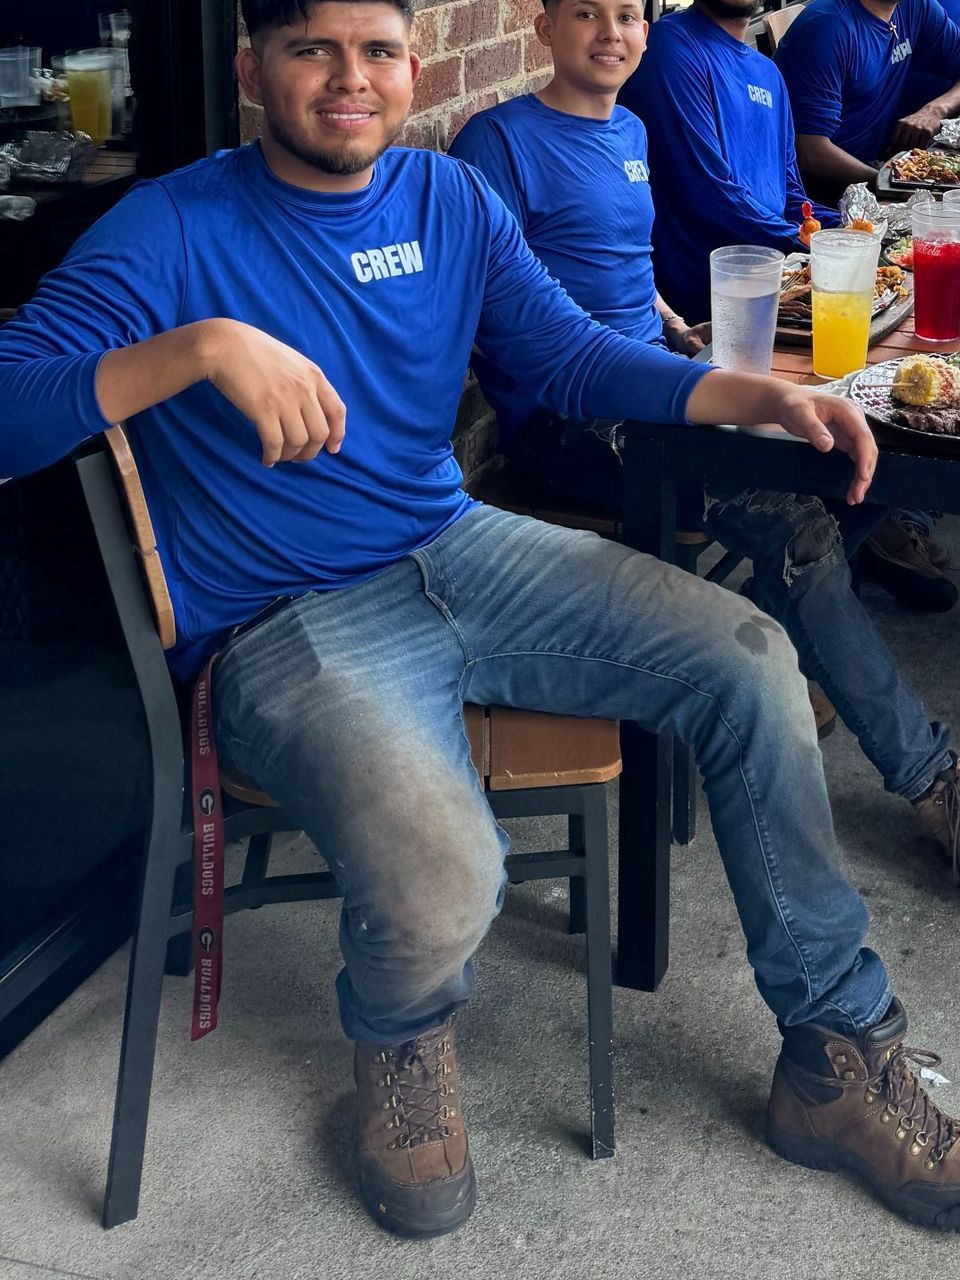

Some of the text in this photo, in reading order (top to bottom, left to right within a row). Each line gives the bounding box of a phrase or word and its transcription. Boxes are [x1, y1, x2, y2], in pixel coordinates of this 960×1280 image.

[747, 84, 773, 109] CREW
[351, 240, 424, 283] CREW
[198, 681, 210, 756] BULLDOGS
[202, 822, 215, 896] BULLDOGS
[199, 958, 212, 1030] BULLDOGS
